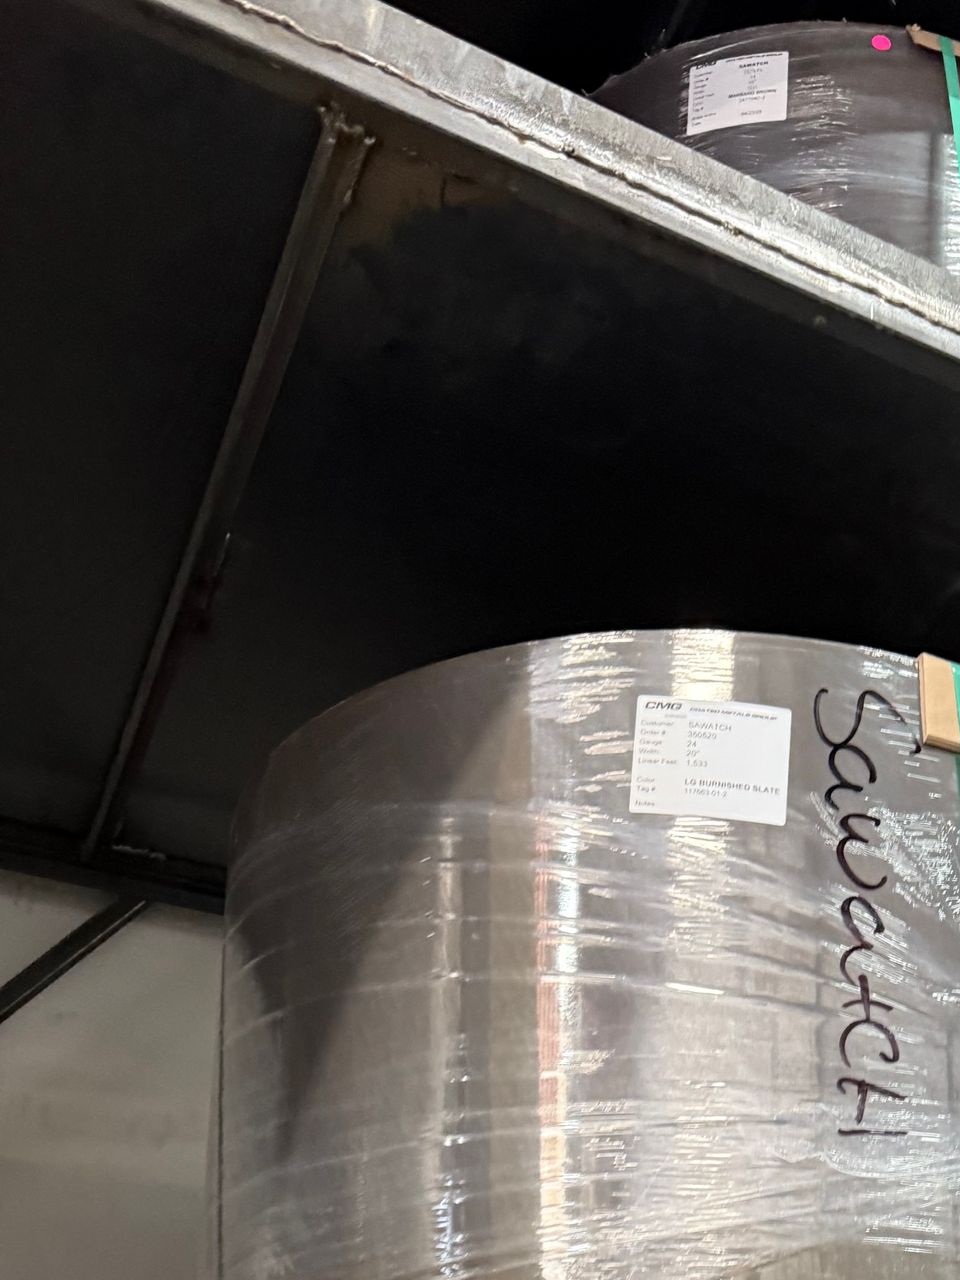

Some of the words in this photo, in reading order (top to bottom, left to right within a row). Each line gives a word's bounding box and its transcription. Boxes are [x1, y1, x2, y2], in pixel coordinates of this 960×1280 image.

[645, 701, 682, 710] CMG
[688, 721, 732, 732] SAWATCH
[684, 778, 697, 786] LG
[699, 779, 750, 791] BURNISHED
[752, 785, 780, 795] SLATE
